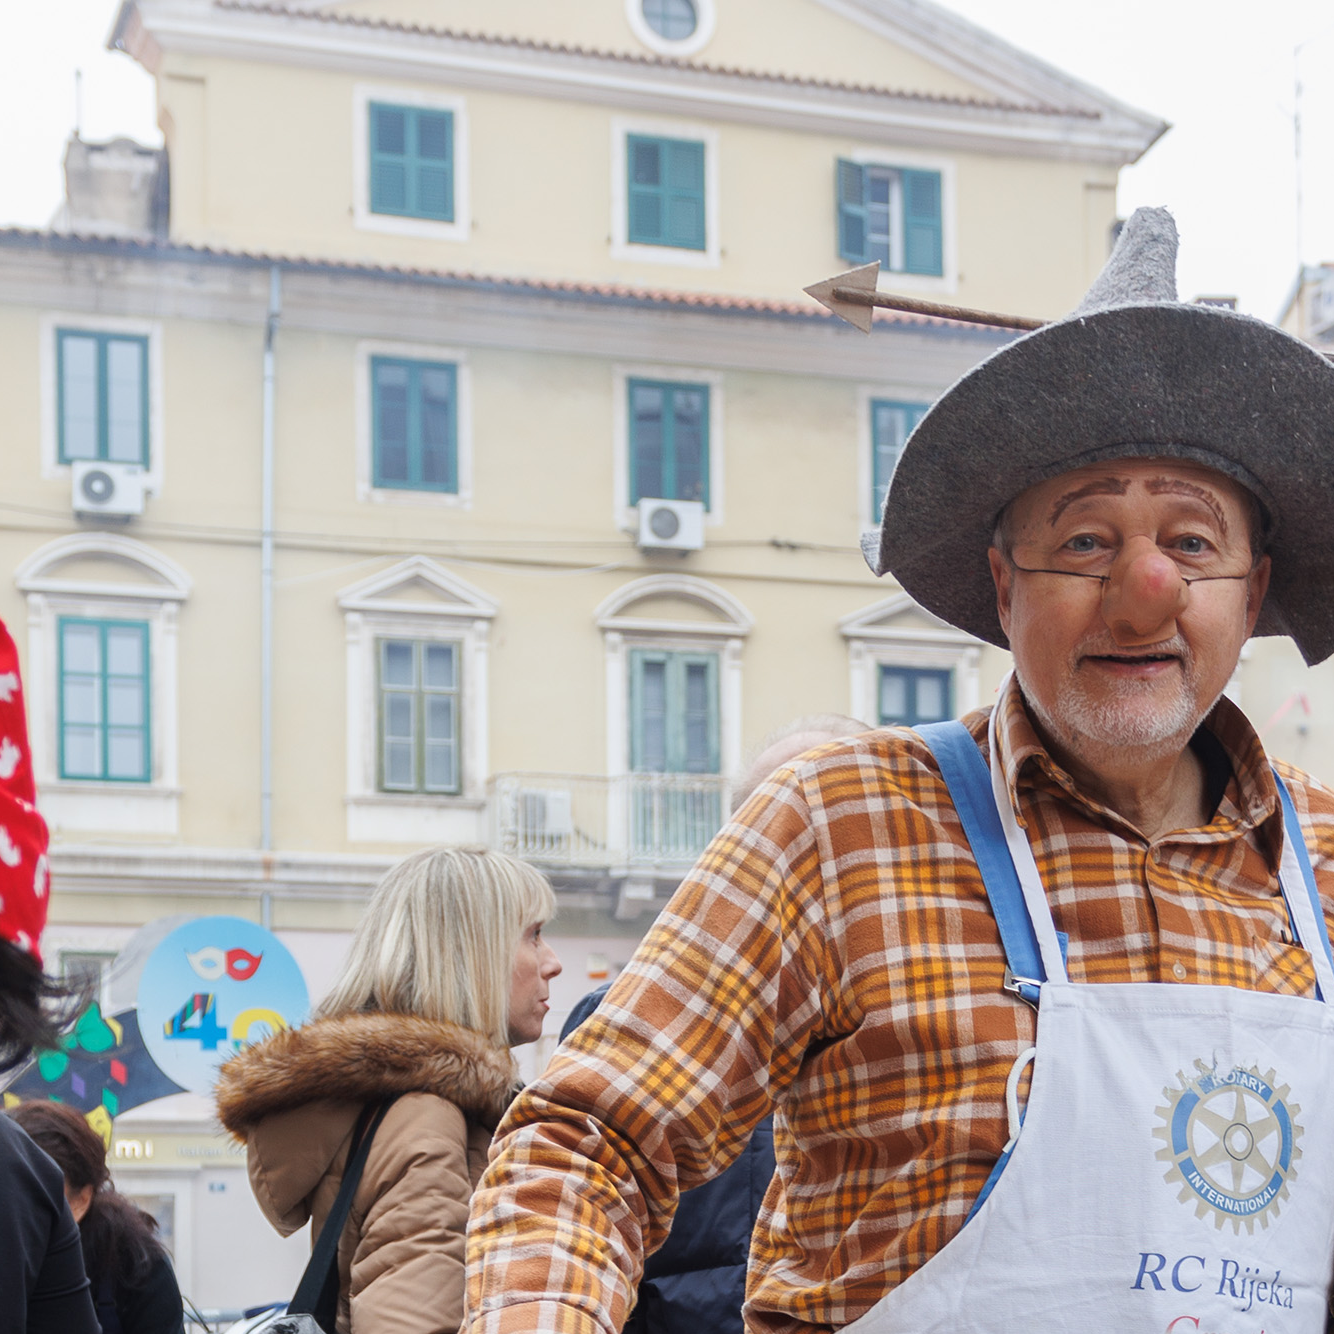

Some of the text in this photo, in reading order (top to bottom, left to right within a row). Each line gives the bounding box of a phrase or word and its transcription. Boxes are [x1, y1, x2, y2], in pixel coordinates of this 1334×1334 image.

[1187, 1169, 1278, 1215] INTERNATIONAL
[1130, 1252, 1296, 1313] RC Rijeka
